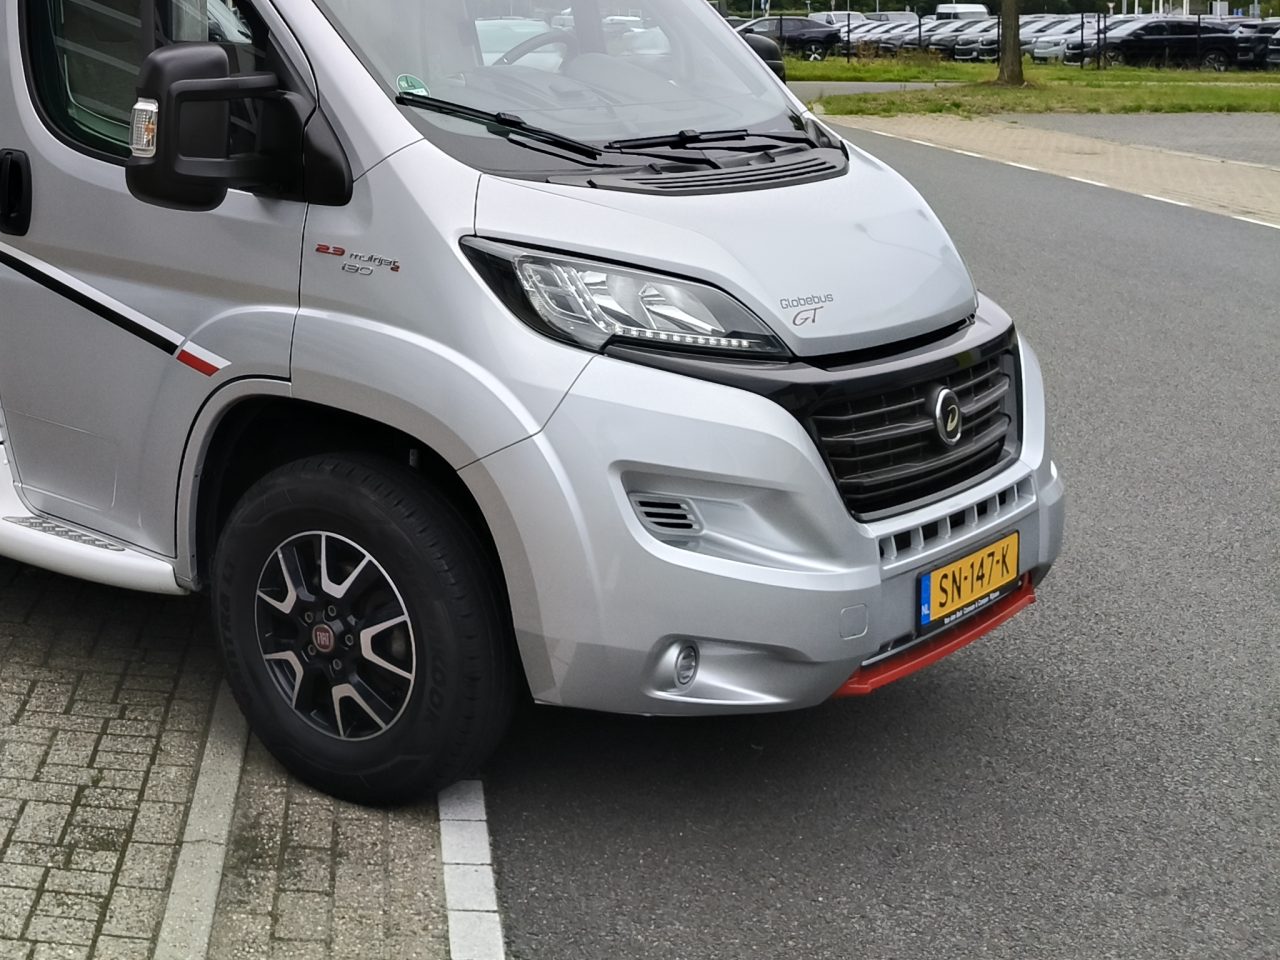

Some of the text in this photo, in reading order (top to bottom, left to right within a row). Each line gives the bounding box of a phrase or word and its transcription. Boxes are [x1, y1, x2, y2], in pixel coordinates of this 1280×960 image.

[780, 293, 834, 310] Globebus
[792, 305, 825, 327] GT
[938, 543, 1010, 608] SN-147-K
